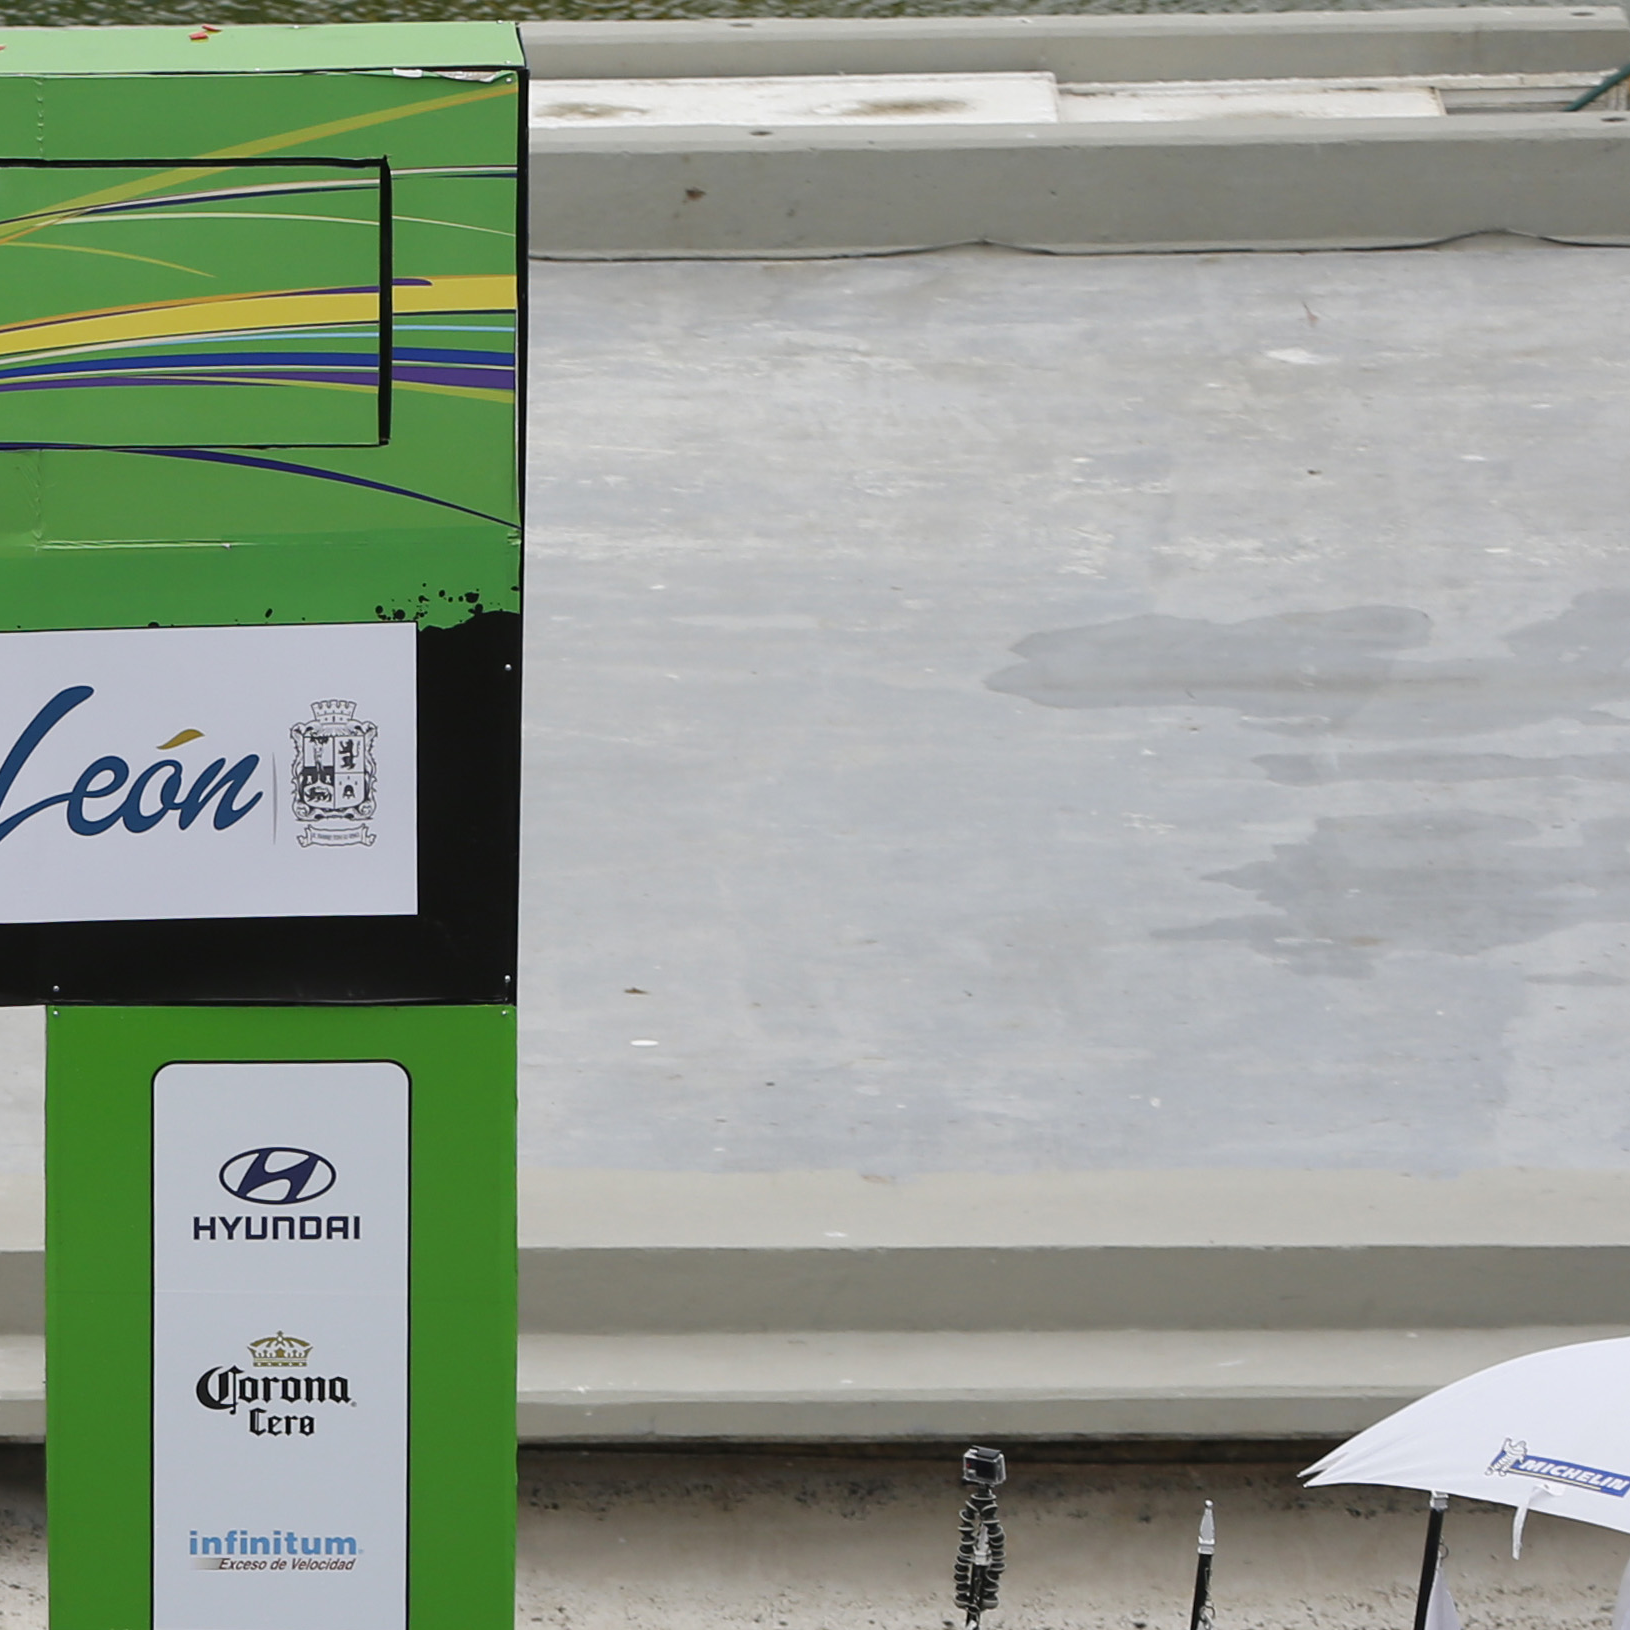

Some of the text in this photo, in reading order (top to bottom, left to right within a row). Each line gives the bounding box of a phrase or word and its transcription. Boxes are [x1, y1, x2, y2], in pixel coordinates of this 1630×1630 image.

[193, 1215, 361, 1240] HYUNDAI
[195, 1365, 352, 1415] Corona
[248, 1408, 316, 1437] Cero
[1518, 1459, 1630, 1491] MICHELIN
[189, 1530, 357, 1556] infinitum
[219, 1557, 356, 1571] Exceso de Velocidad
